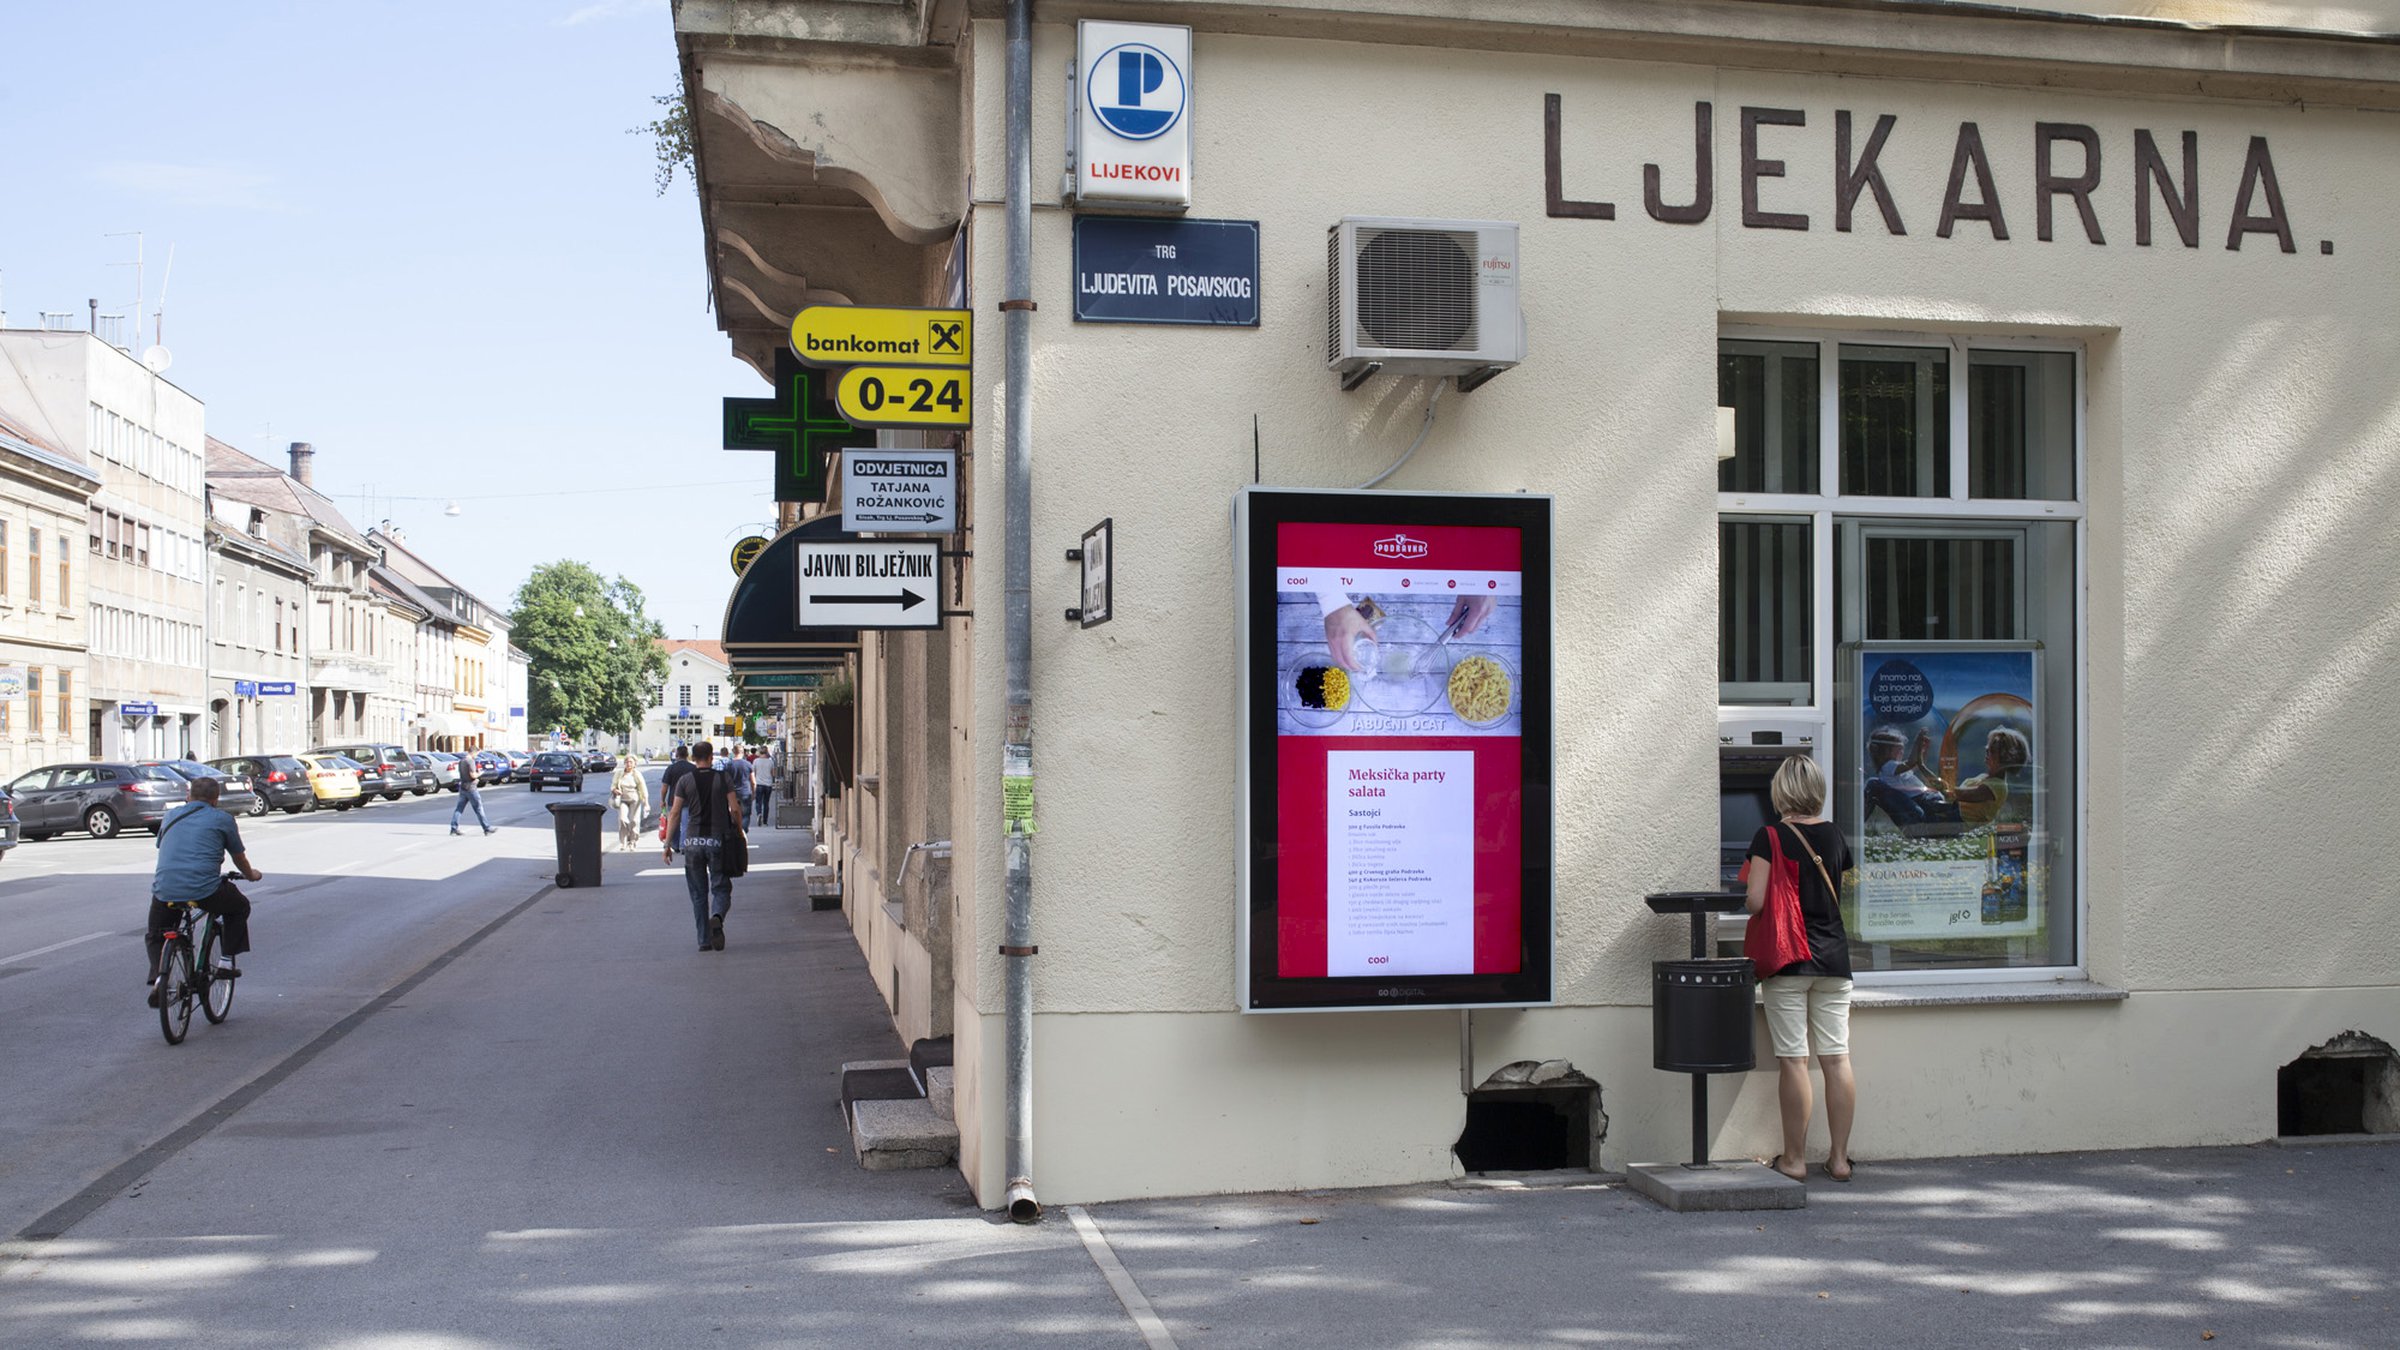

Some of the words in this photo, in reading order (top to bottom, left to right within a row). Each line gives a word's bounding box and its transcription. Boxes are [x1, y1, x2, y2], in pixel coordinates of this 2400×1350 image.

[1091, 162, 1180, 182] LIJEKOVI
[1544, 92, 2333, 255] LJEKARNA.
[1155, 244, 1176, 259] TRG
[1482, 258, 1511, 270] FUJITSU
[1081, 272, 1158, 295] LJUDEVITA
[1167, 275, 1251, 298] POSAVSKOG
[806, 333, 920, 354] bankomat
[858, 376, 963, 413] 0-24
[855, 462, 945, 475] ODVJETNICA
[870, 482, 931, 493] TATJANA
[856, 494, 945, 508] ROŽANKOVIĆ
[1377, 543, 1424, 553] PODRAVKA
[803, 554, 851, 578] JAVNI
[855, 549, 933, 578] BILJEŽNIK
[1340, 577, 1353, 586] TV
[1880, 673, 1908, 681] Imamo
[1879, 684, 1889, 692] za
[1889, 683, 1923, 693] inovacije
[1873, 694, 1890, 703] koje
[1880, 704, 1892, 713] od
[1351, 716, 1407, 732] JABUČNI
[1412, 719, 1447, 731] OCAT
[1348, 768, 1409, 781] Meksička
[1412, 769, 1446, 784] party
[1348, 785, 1386, 798] salata
[1348, 808, 1381, 818] Sastojci
